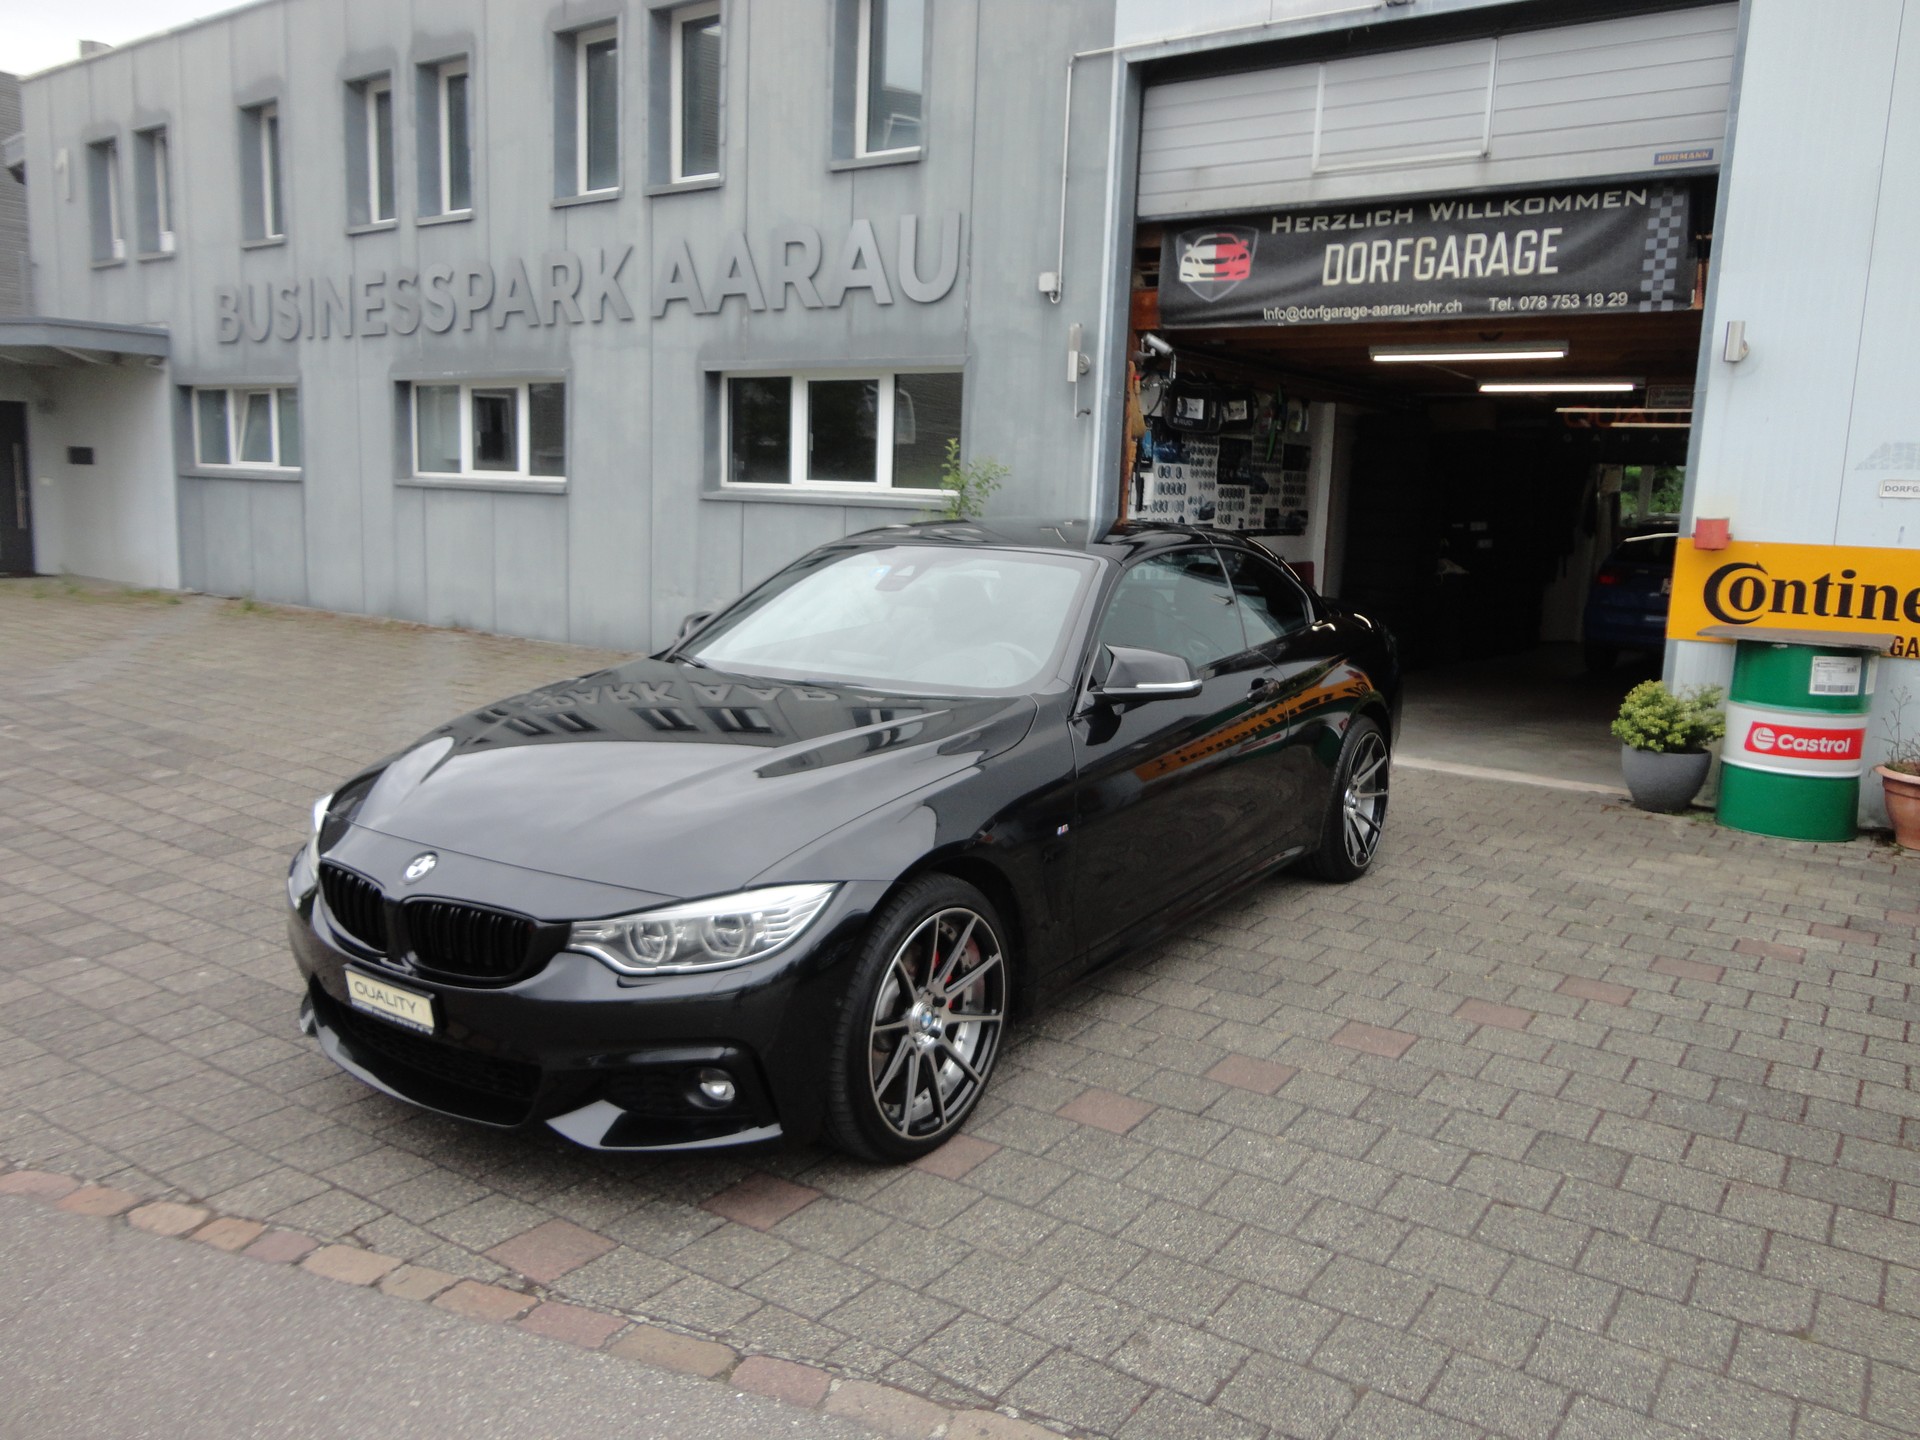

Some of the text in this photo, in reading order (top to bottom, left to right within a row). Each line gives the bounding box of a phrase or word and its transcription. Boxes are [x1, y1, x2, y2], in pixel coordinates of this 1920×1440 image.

[1271, 189, 1647, 235] HERZLICH WILLKOMMEN
[1322, 227, 1562, 286] DORFGARAGE
[215, 212, 962, 344] BUSINESSPARK AARAU
[1263, 299, 1463, 322] Info@dorfgarage-aarau-rohr.ch
[1489, 292, 1629, 311] Tel. 078 753 19 29
[1884, 485, 1920, 493] DORFG
[1778, 733, 1852, 754] Castrol
[354, 981, 416, 1013] QUALITY
